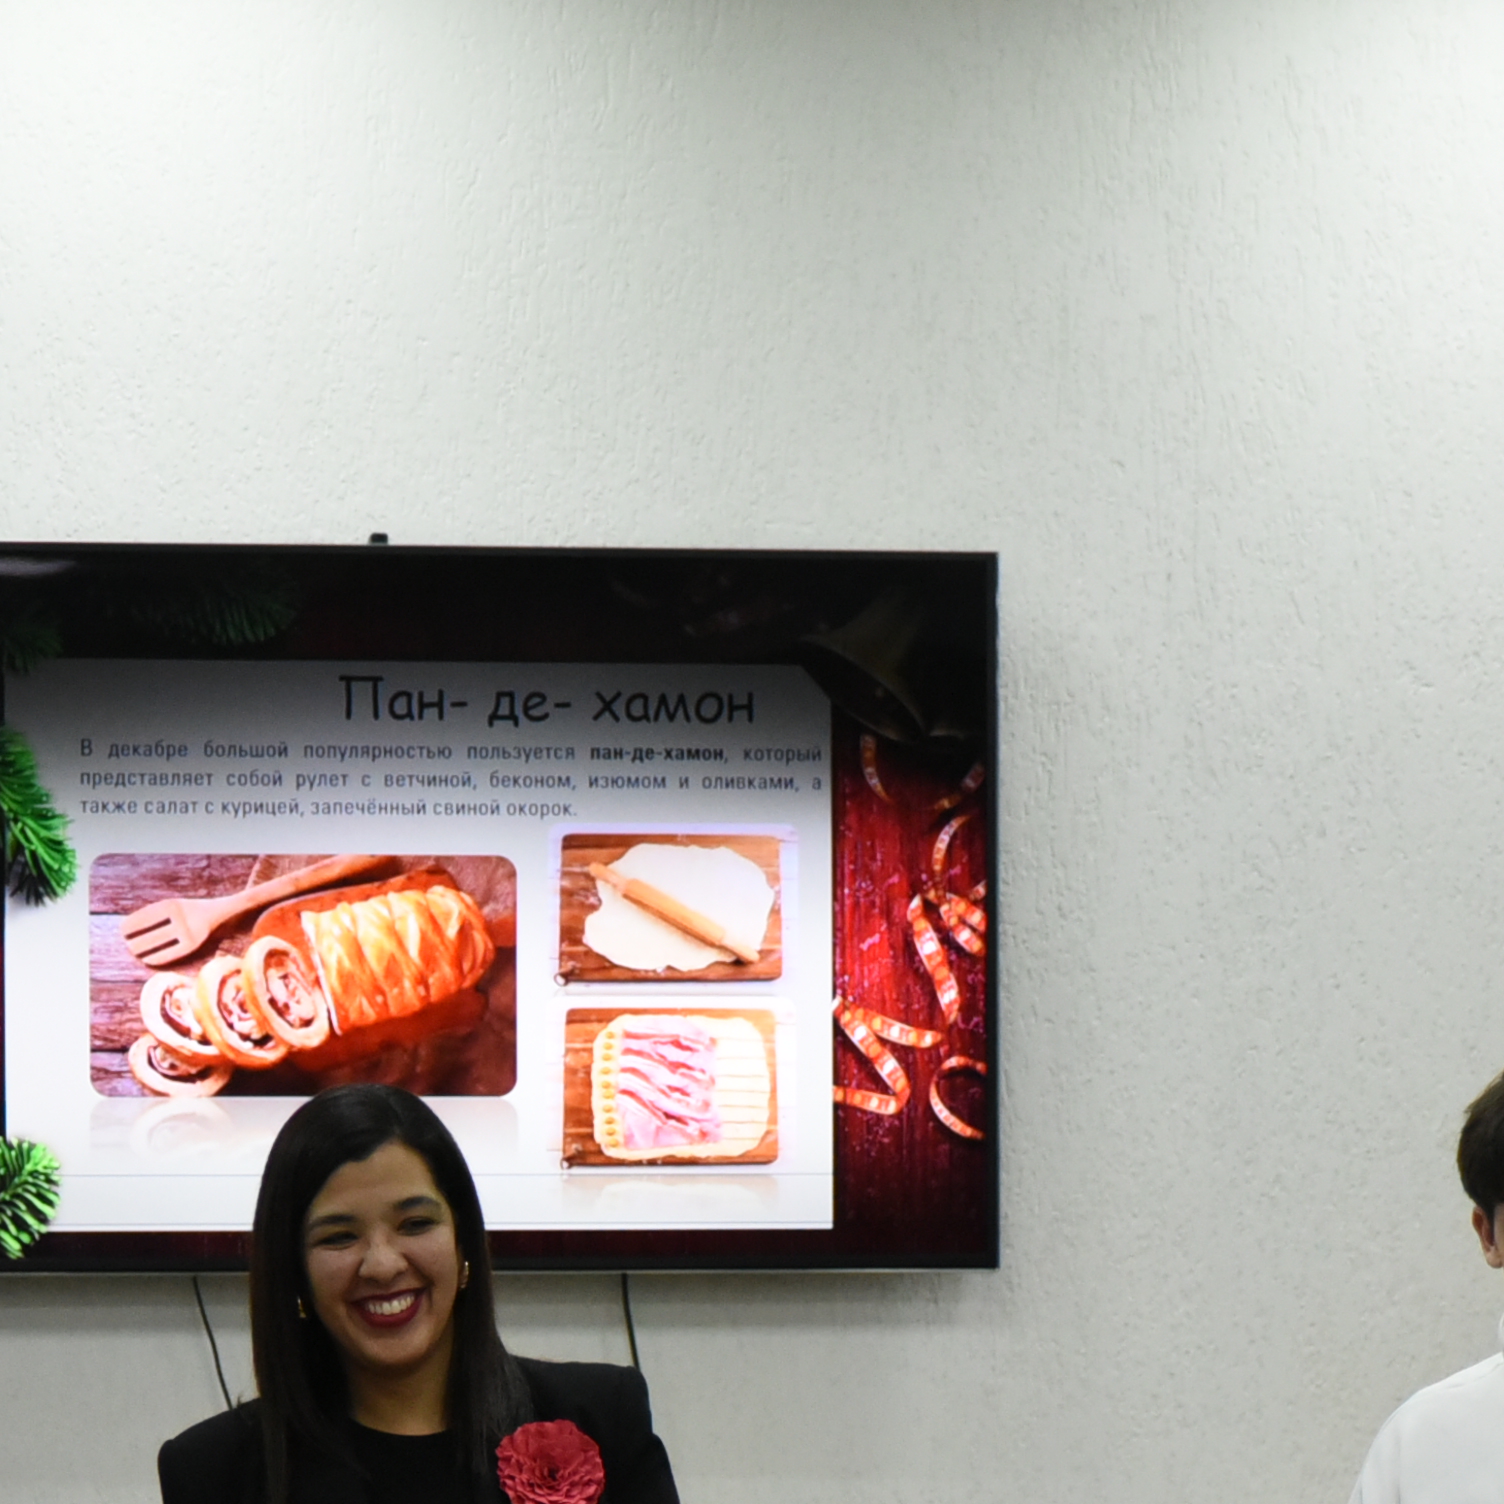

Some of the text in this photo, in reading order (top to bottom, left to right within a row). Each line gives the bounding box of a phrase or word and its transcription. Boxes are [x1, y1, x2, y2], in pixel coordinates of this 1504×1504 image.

[338, 674, 755, 728] Пан- де- хамон
[79, 739, 822, 766] В декабре большой популярностью пользуется пан-де-хамон, который
[79, 769, 822, 793] представляет собой рулет с ветчиной, беконом, изюмом и оливками, а
[80, 796, 578, 819] также салат с курицей, запечённый свиной окорок.
